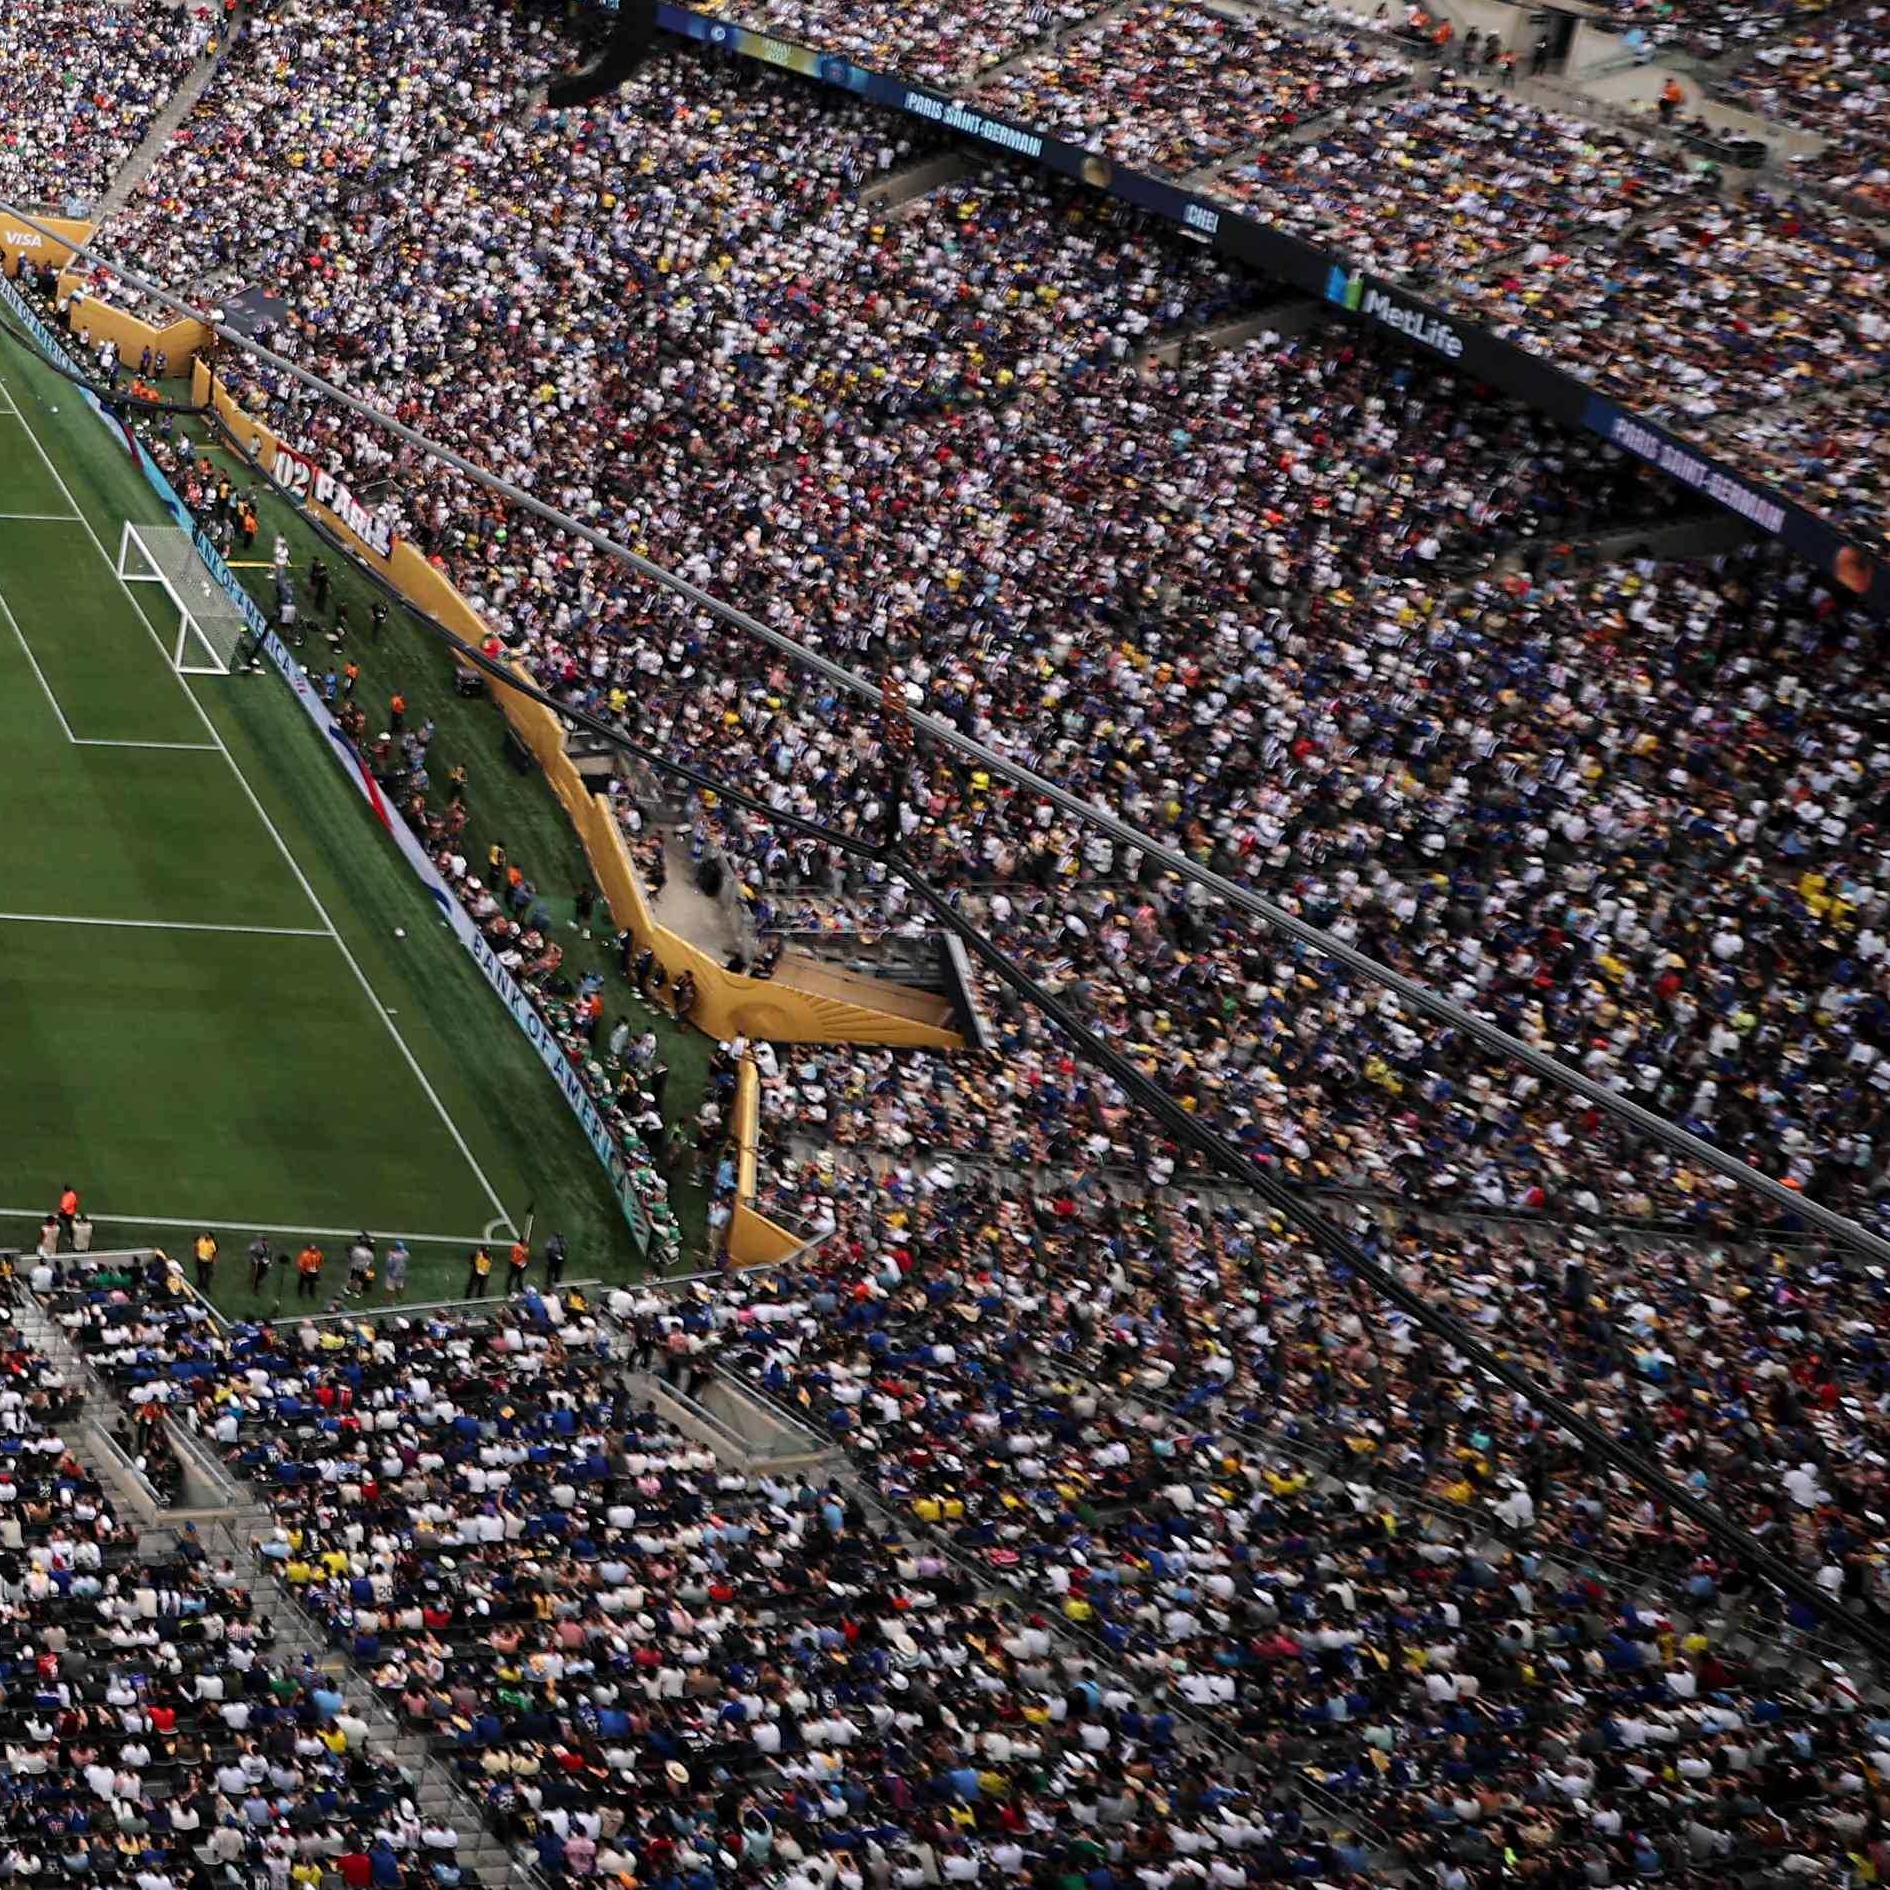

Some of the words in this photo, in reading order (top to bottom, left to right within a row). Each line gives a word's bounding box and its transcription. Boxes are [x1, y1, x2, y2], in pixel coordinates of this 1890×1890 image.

[904, 91, 944, 119] PARIS
[943, 107, 1043, 158] SAINT-GERMAIN
[5, 230, 43, 247] VISA
[1363, 287, 1463, 359] MetLife
[237, 594, 293, 676] AMEICA
